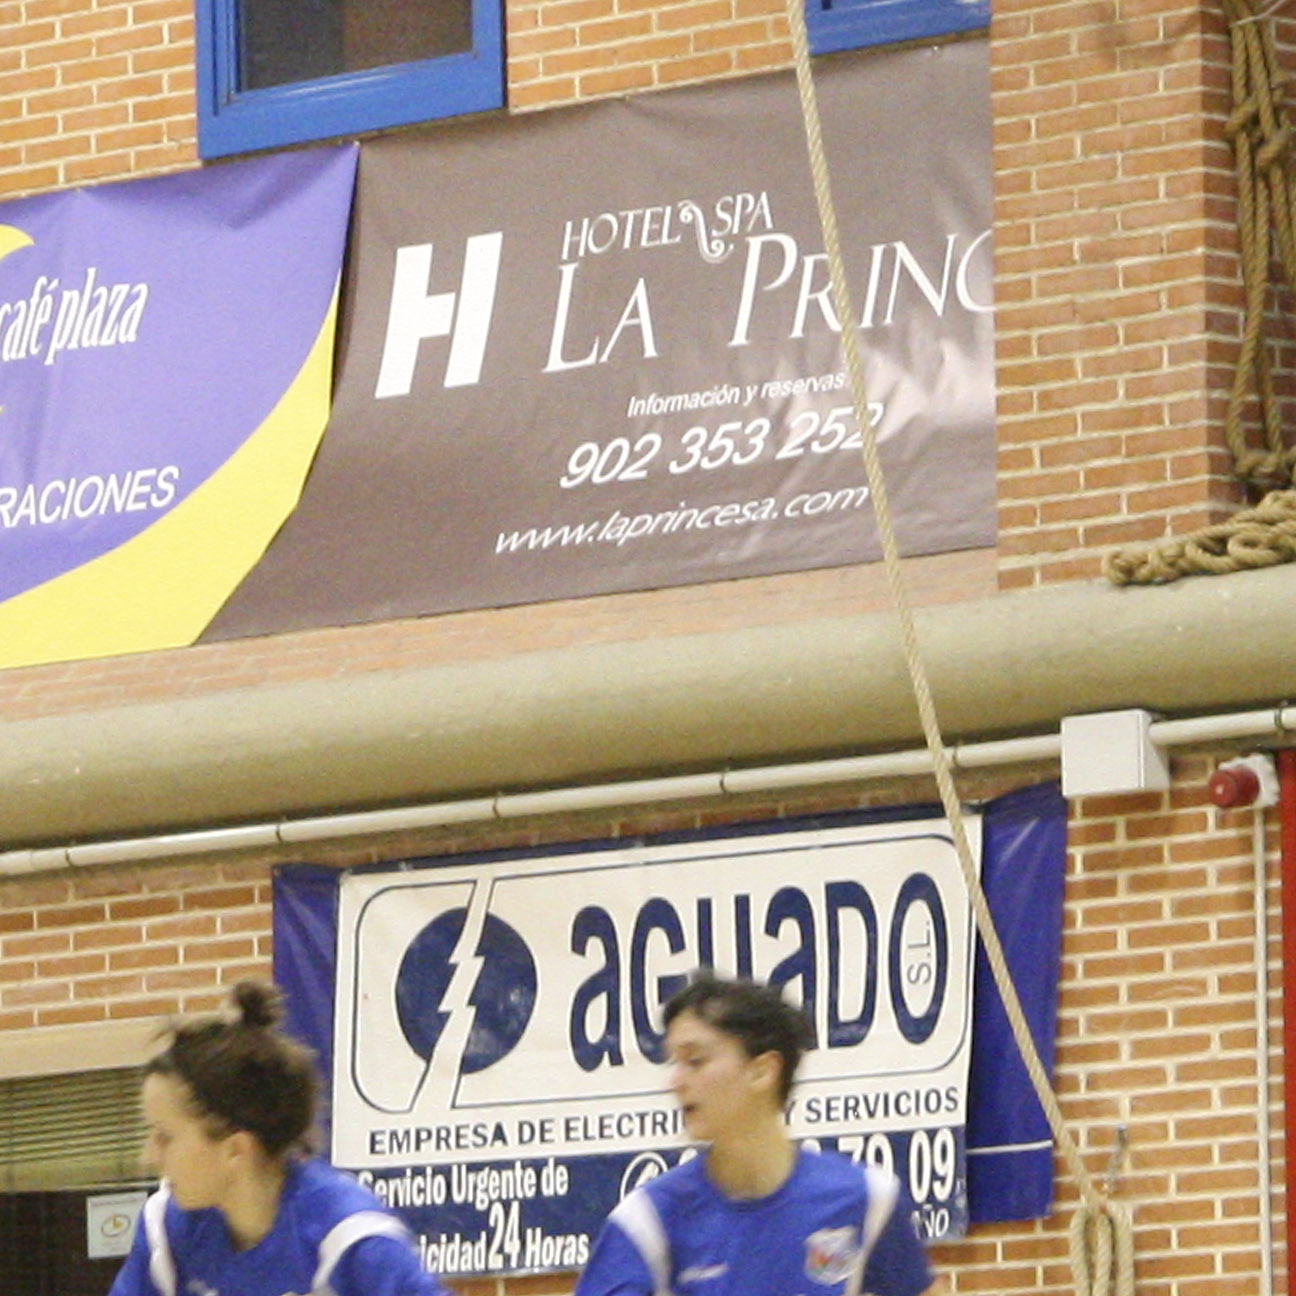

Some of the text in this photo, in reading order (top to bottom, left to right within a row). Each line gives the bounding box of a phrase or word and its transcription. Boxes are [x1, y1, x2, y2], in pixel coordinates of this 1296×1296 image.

[562, 191, 774, 260] HOTEL SPA
[43, 266, 149, 366] plaza
[541, 262, 660, 373] LA
[627, 380, 741, 418] Información
[744, 383, 759, 406] y
[559, 402, 884, 489] 902 353 252
[494, 485, 872, 556] www.laprincesa.com
[368, 1120, 510, 1155] EMPRESA
[516, 1117, 556, 1145] DE
[804, 1086, 959, 1124] SERVICIOS
[358, 1157, 569, 1212] Servicio Urgente de
[909, 1127, 955, 1203] 09
[488, 1201, 521, 1270] 24
[525, 1226, 590, 1268] Horas
